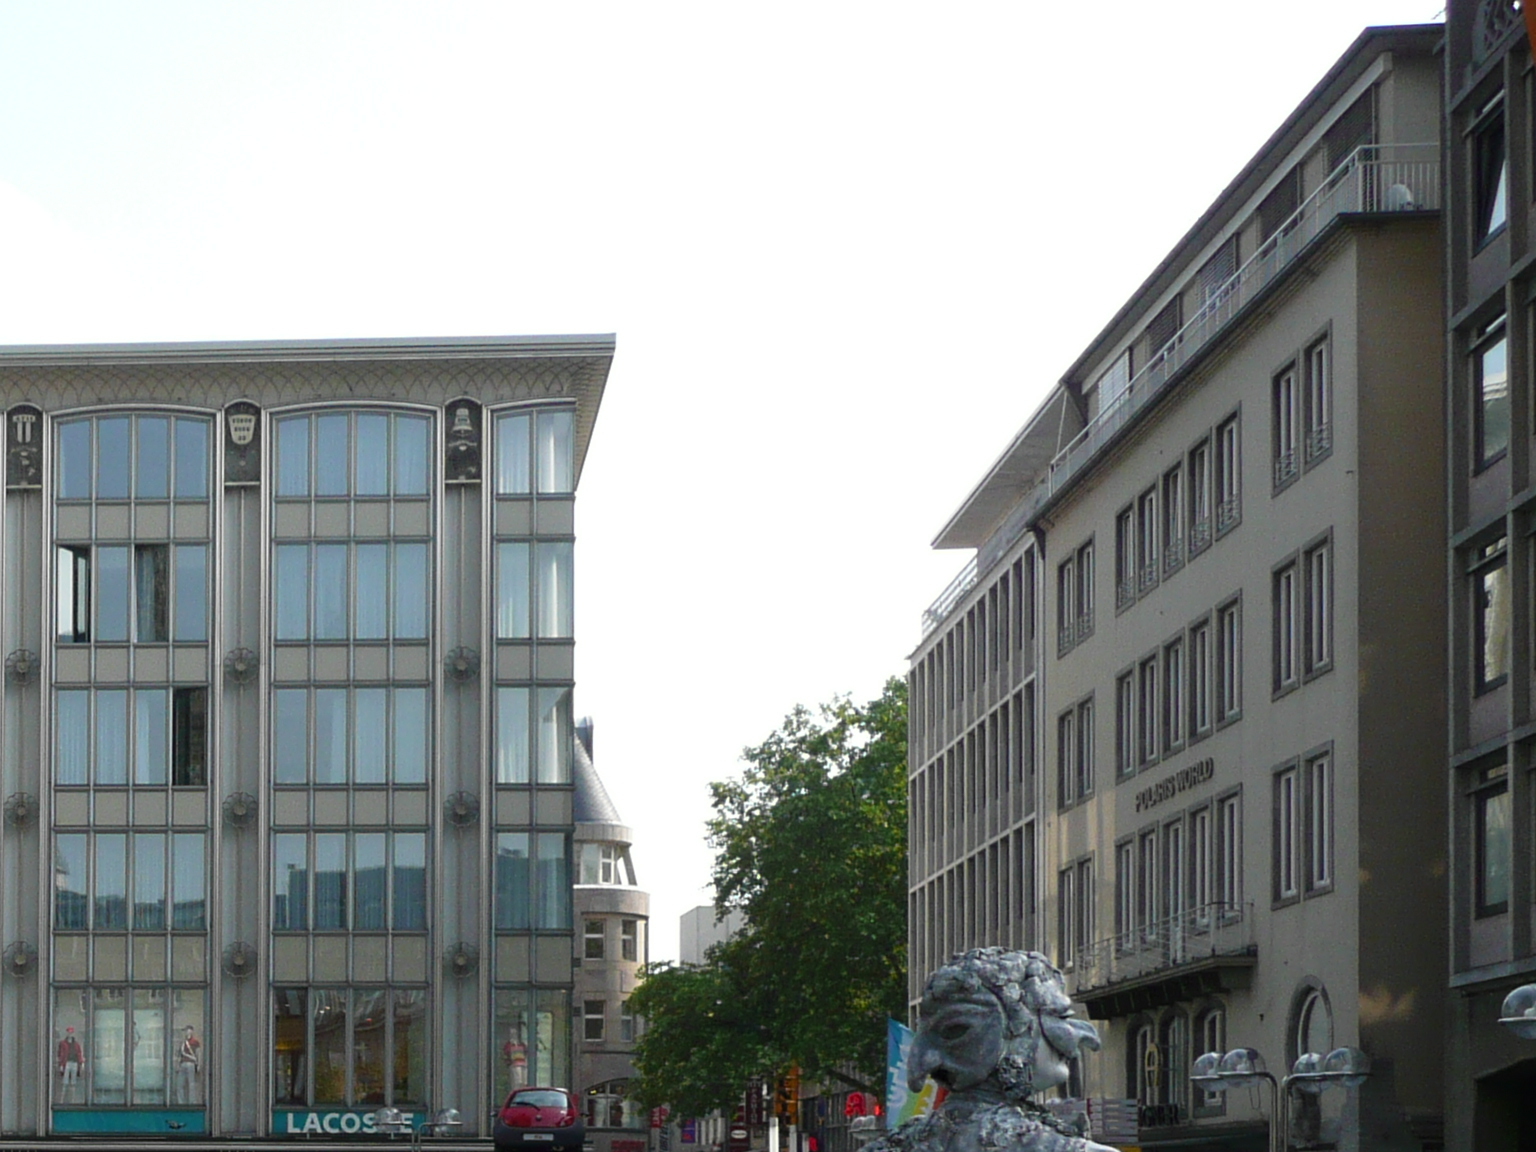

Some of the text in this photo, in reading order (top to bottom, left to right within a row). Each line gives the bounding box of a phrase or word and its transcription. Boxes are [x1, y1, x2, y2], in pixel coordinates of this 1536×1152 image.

[1136, 757, 1214, 812] POLARIS WORLD
[287, 1112, 414, 1134] LACOSE
